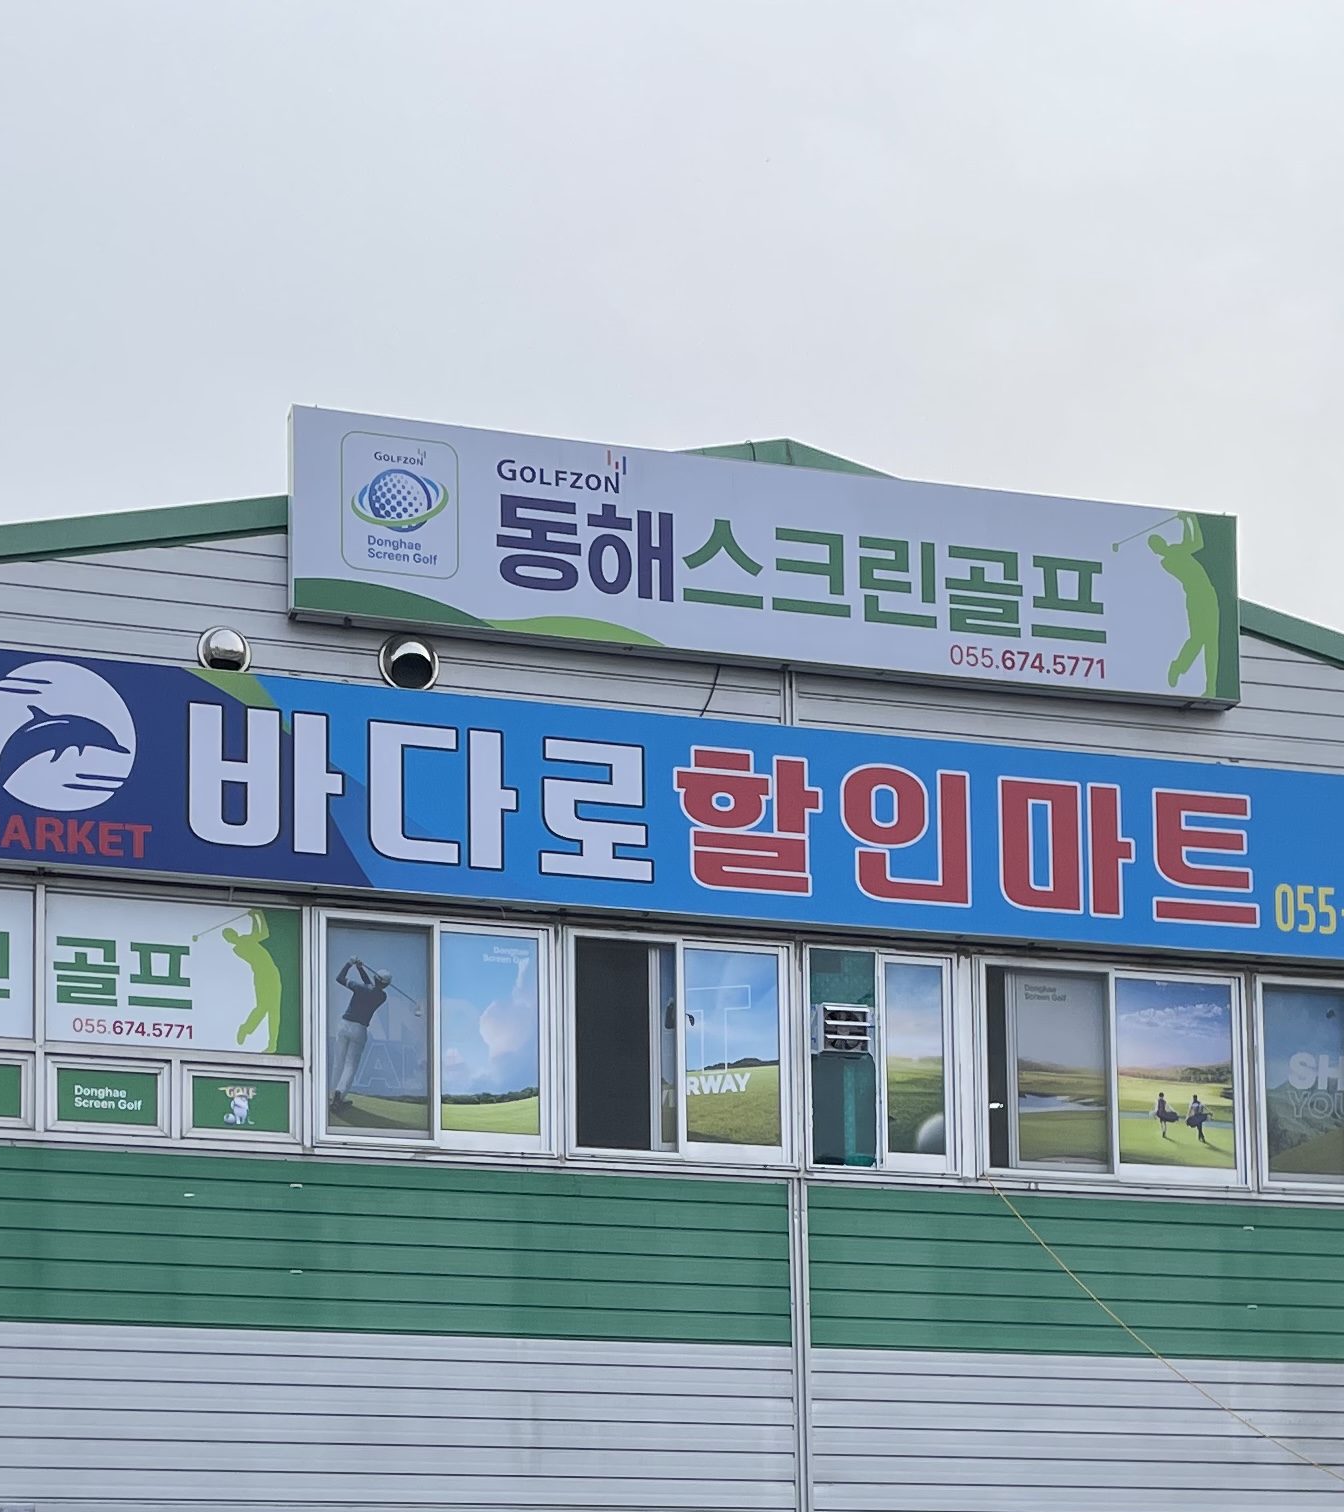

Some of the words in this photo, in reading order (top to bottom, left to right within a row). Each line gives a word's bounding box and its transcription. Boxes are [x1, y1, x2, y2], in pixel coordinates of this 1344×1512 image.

[374, 451, 424, 466] GOLFZON
[496, 456, 623, 496] GOLFZON
[367, 535, 422, 551] Donghae
[367, 548, 410, 563] Screen
[412, 552, 438, 566] Golf
[949, 642, 1108, 680] 055.674.5771
[53, 935, 193, 1010] 골프
[72, 1017, 194, 1040] 055.674.5771
[74, 1084, 127, 1099] Donghae
[74, 1096, 116, 1110] Screen
[118, 1099, 143, 1112] Golf
